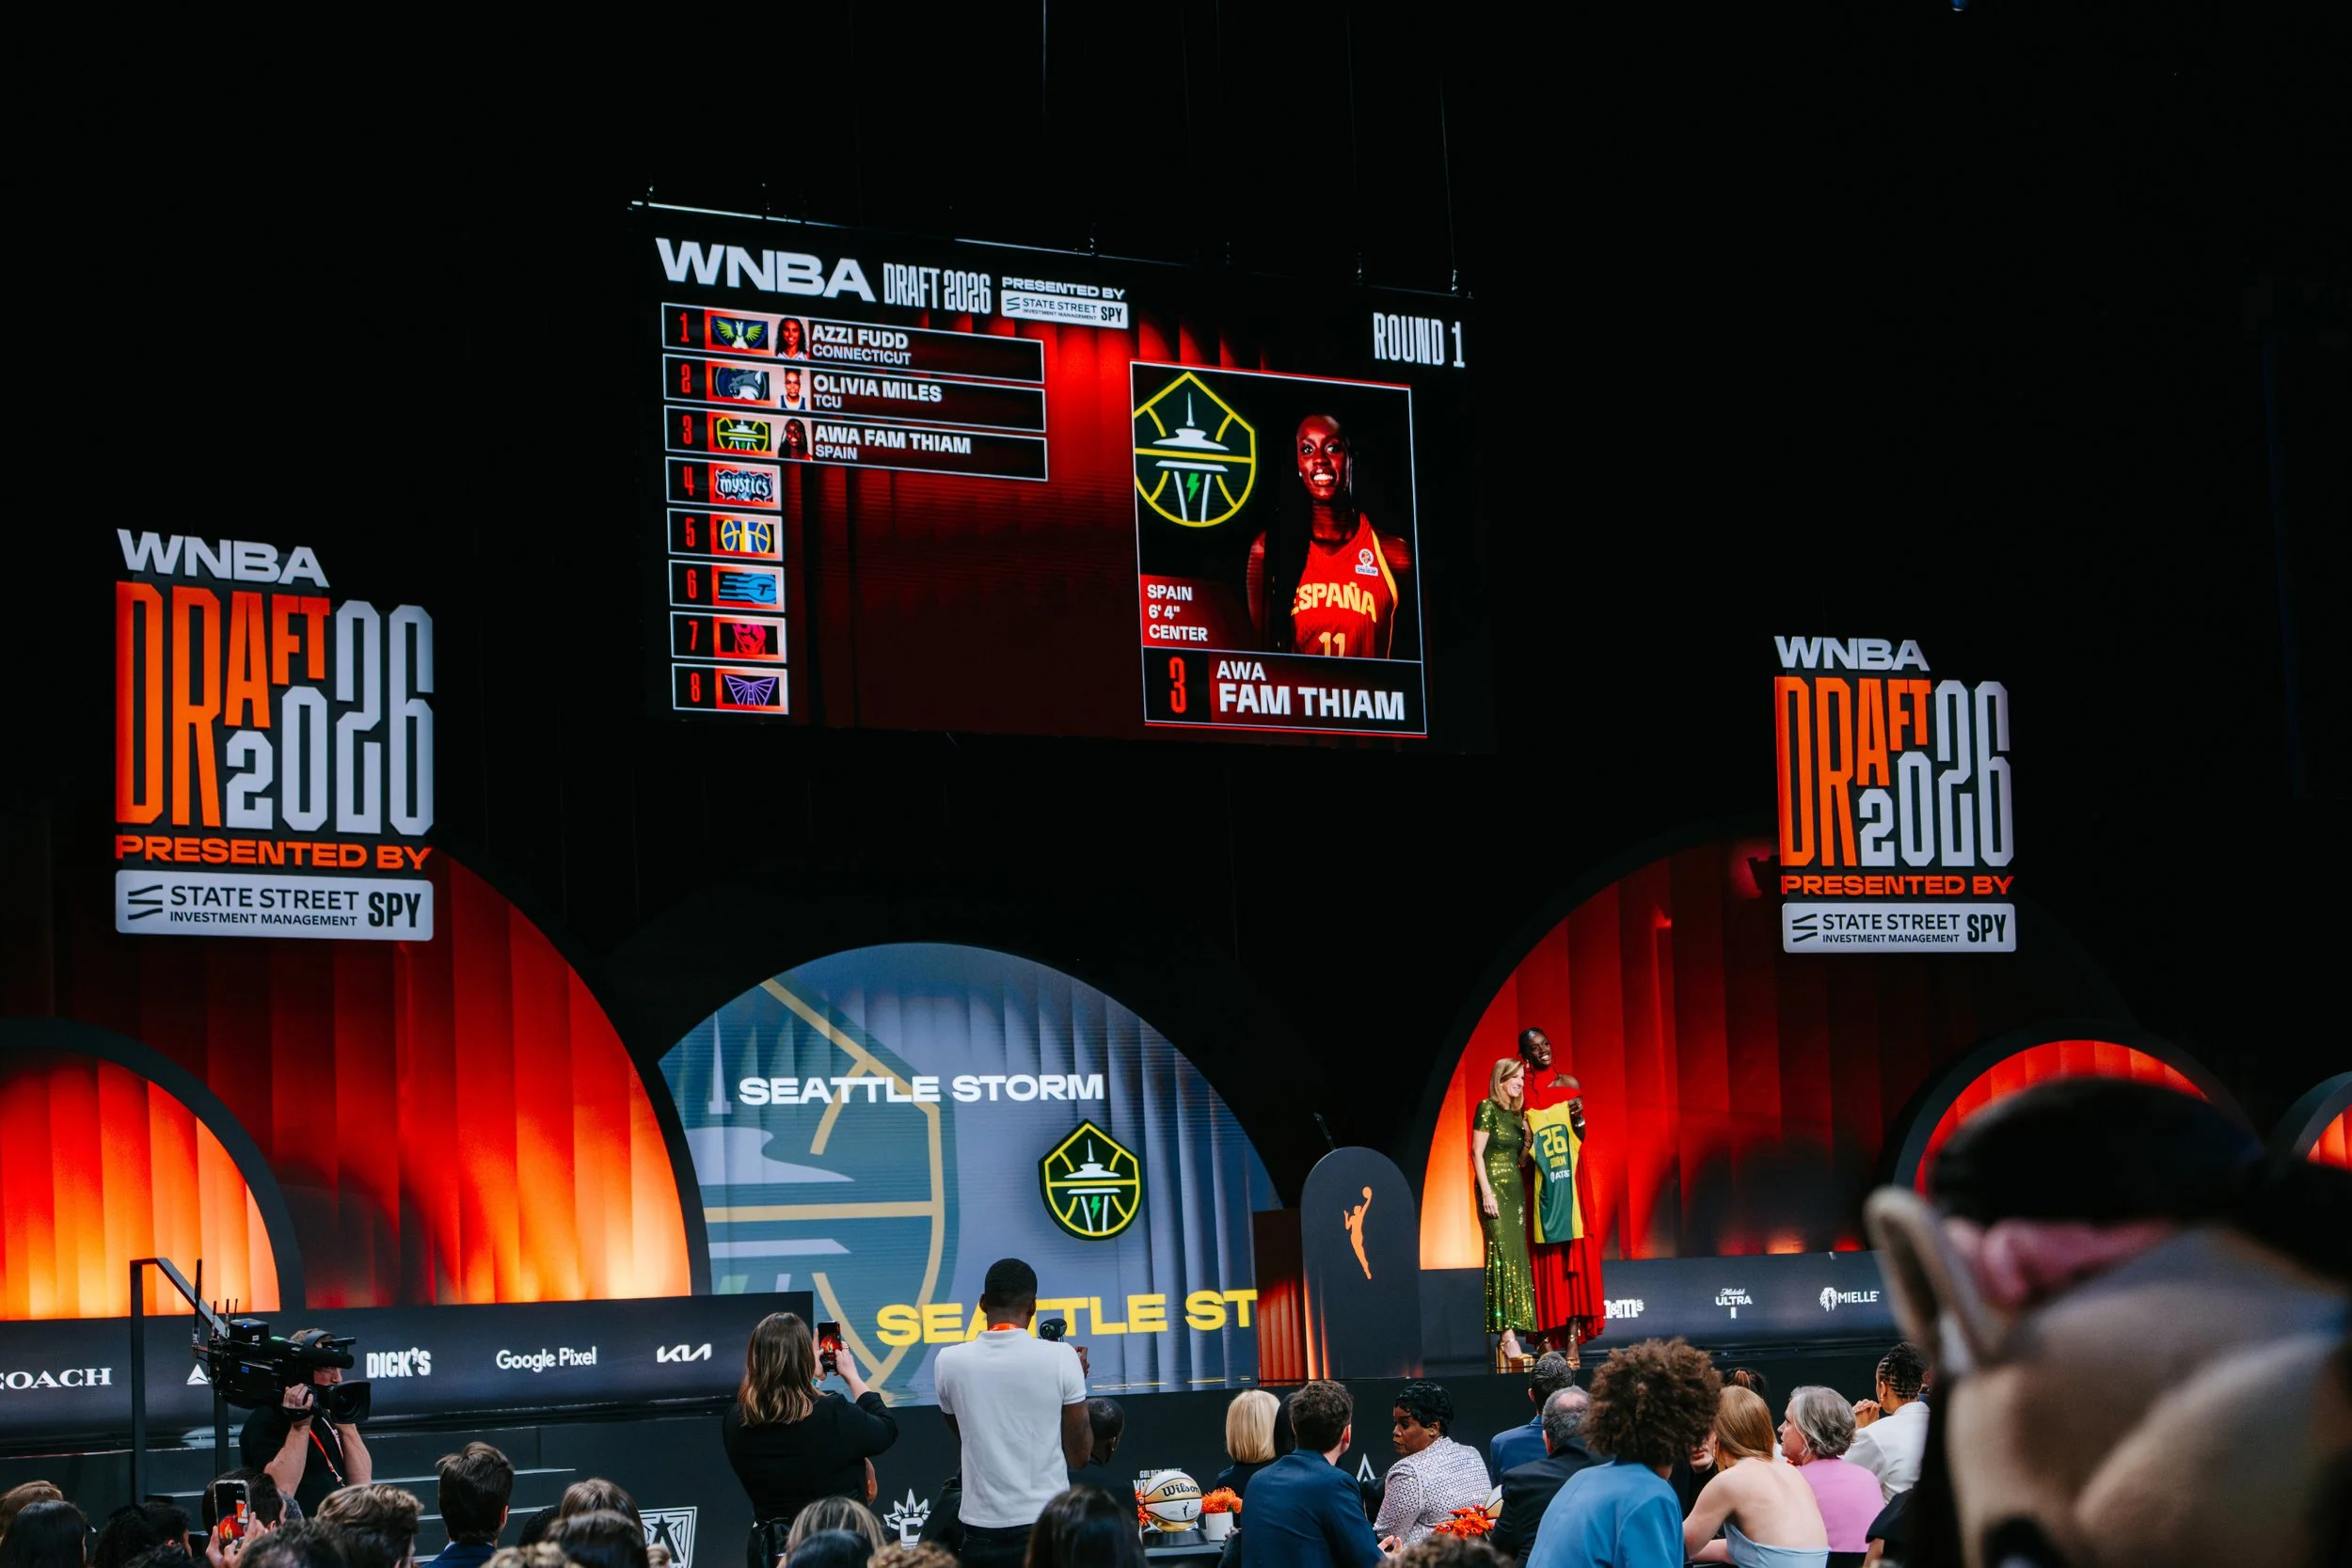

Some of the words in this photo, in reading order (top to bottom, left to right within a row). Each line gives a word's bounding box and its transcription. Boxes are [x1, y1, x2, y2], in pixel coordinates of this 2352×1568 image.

[656, 238, 876, 302] WNBA
[883, 262, 940, 309] DRAFT
[944, 269, 992, 314] 2026
[1002, 277, 1099, 297] PRESENTED
[1102, 287, 1125, 300] BY
[1023, 297, 1056, 309] STATE
[1057, 301, 1097, 313] STREET
[1101, 306, 1122, 323] SPY
[679, 312, 690, 343] 1
[812, 325, 853, 344] AZZI
[858, 328, 908, 350] FUDD
[1373, 312, 1444, 366] ROUND
[1452, 321, 1466, 368] 1
[812, 343, 912, 366] CONNECTICUT
[681, 363, 691, 394] 2
[813, 374, 879, 397] OLIVIA
[882, 379, 942, 403] MILES
[814, 393, 842, 409] TCU
[682, 415, 692, 445] 3
[815, 425, 862, 445] AWA
[865, 429, 906, 450] FAM
[909, 432, 971, 454] THIAM
[815, 444, 857, 460] SPAIN
[683, 466, 694, 497] 4
[685, 517, 695, 547] 5
[117, 528, 330, 588] WNBA
[687, 569, 697, 599] 6
[1147, 583, 1192, 601] SPAIN
[689, 621, 698, 651] 7
[1149, 625, 1208, 642] CENTER
[1318, 631, 1345, 657] 11
[1774, 636, 1931, 672] WNBA
[1168, 656, 1186, 714] 3
[1216, 660, 1266, 681] AWA
[691, 672, 701, 703] 8
[1218, 683, 1291, 715] FAM
[1298, 686, 1406, 721] THIAM
[115, 580, 330, 828] DRAFT
[226, 599, 434, 836] 2026
[1774, 676, 1931, 866] DRAFT
[1858, 679, 2014, 866] 2026
[115, 834, 368, 869] PRESENTED
[376, 845, 434, 871] BY
[1780, 875, 1965, 895] PRESENTED
[1972, 876, 2015, 895] BY
[170, 885, 252, 908] STATE
[259, 887, 358, 911] STREET
[368, 891, 421, 928] SPY
[170, 911, 258, 925] INVESTMENT
[261, 913, 358, 927] MANAGEMENT
[1822, 913, 1882, 930] STATE
[1886, 913, 1961, 930] STREET
[1967, 913, 2007, 942] SPY
[1822, 934, 1886, 942] INVESTMENT
[1888, 934, 1960, 942] MANAGEMENT
[739, 1075, 940, 1106] SEATTLE
[951, 1073, 1104, 1103] STORM
[1538, 1126, 1568, 1158] 26
[1715, 1295, 1753, 1307] ULTRA
[366, 1346, 432, 1379] DICK'S
[496, 1348, 556, 1373] Google
[559, 1345, 597, 1367] Pixel
[1162, 1482, 1200, 1497] Wilson
